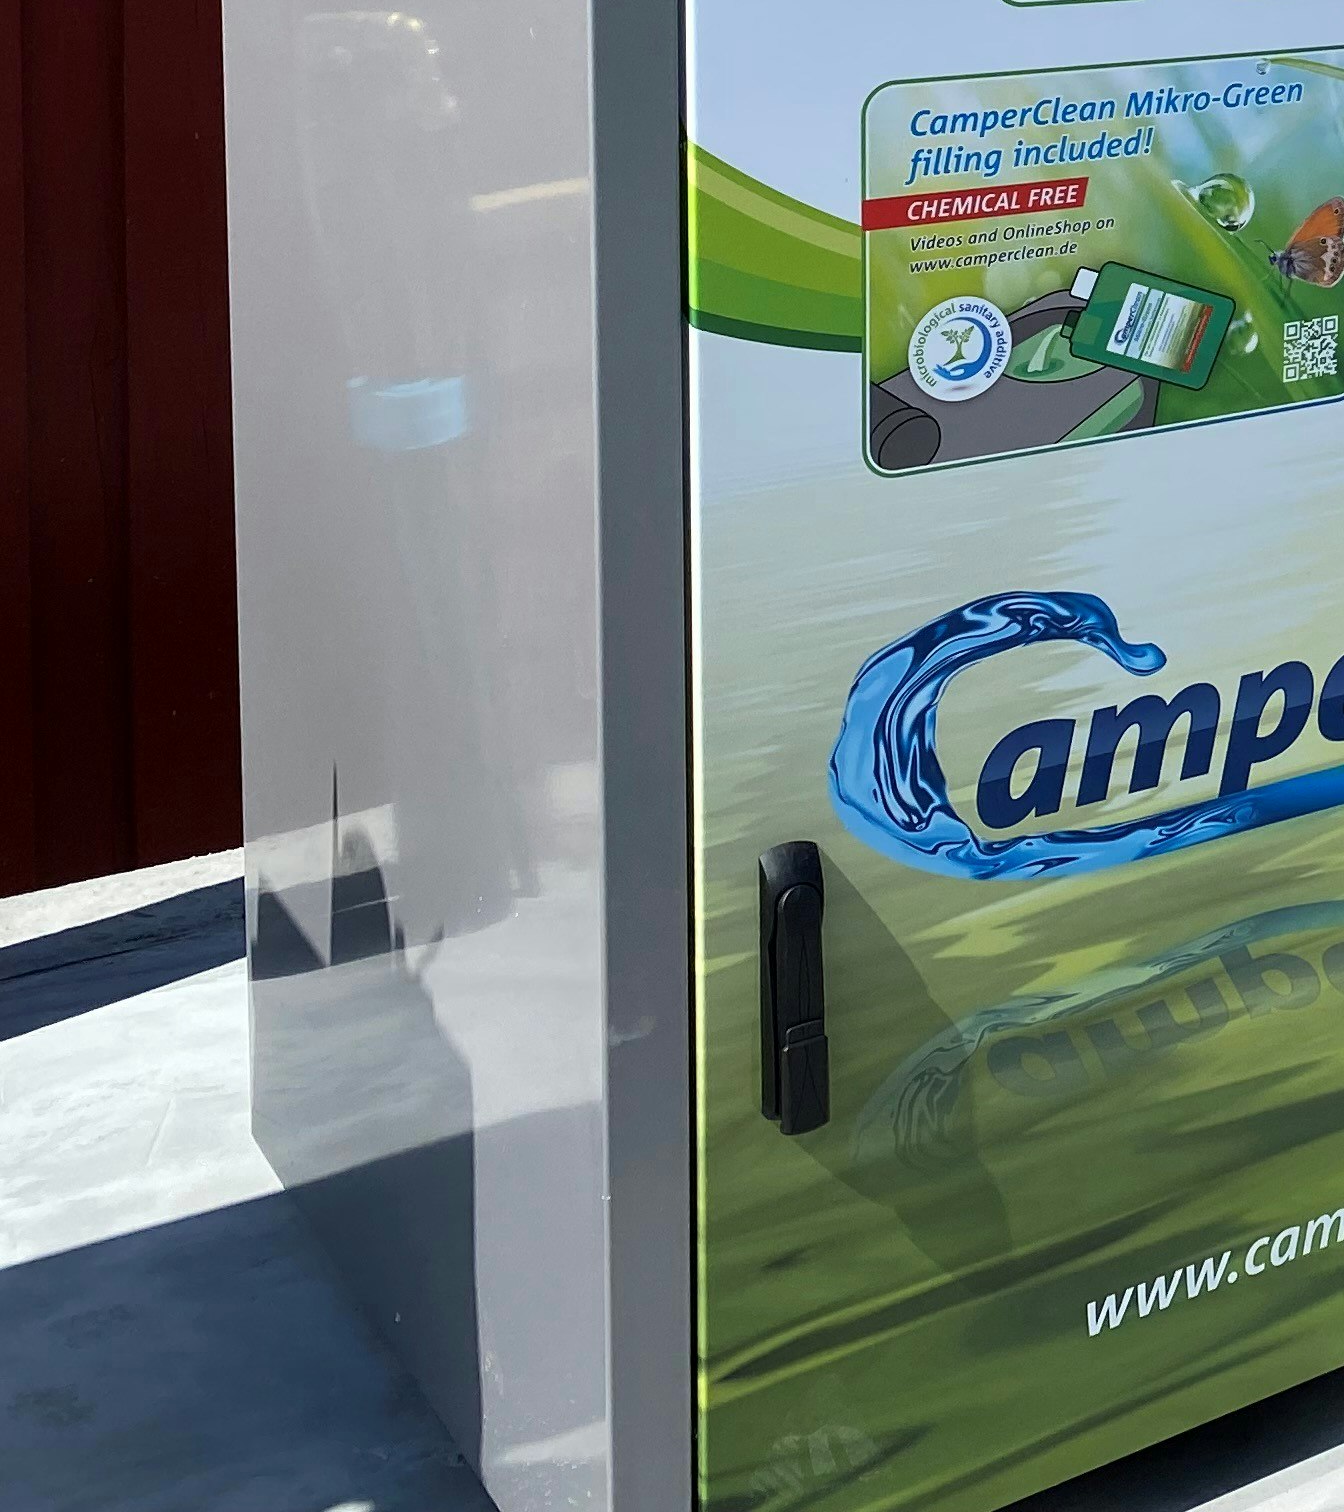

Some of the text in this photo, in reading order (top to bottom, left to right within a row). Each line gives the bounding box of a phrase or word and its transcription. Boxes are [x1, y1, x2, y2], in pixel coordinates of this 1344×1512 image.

[909, 80, 1304, 137] CamperClean Mikro-Green
[905, 128, 1154, 186] filling included!
[907, 184, 1079, 222] CHEMICAL FREE
[910, 216, 1115, 252] Videos and OnlineShop on
[909, 242, 1078, 274] www.camperclean.de
[913, 303, 1008, 387] microbiological sanitary additive
